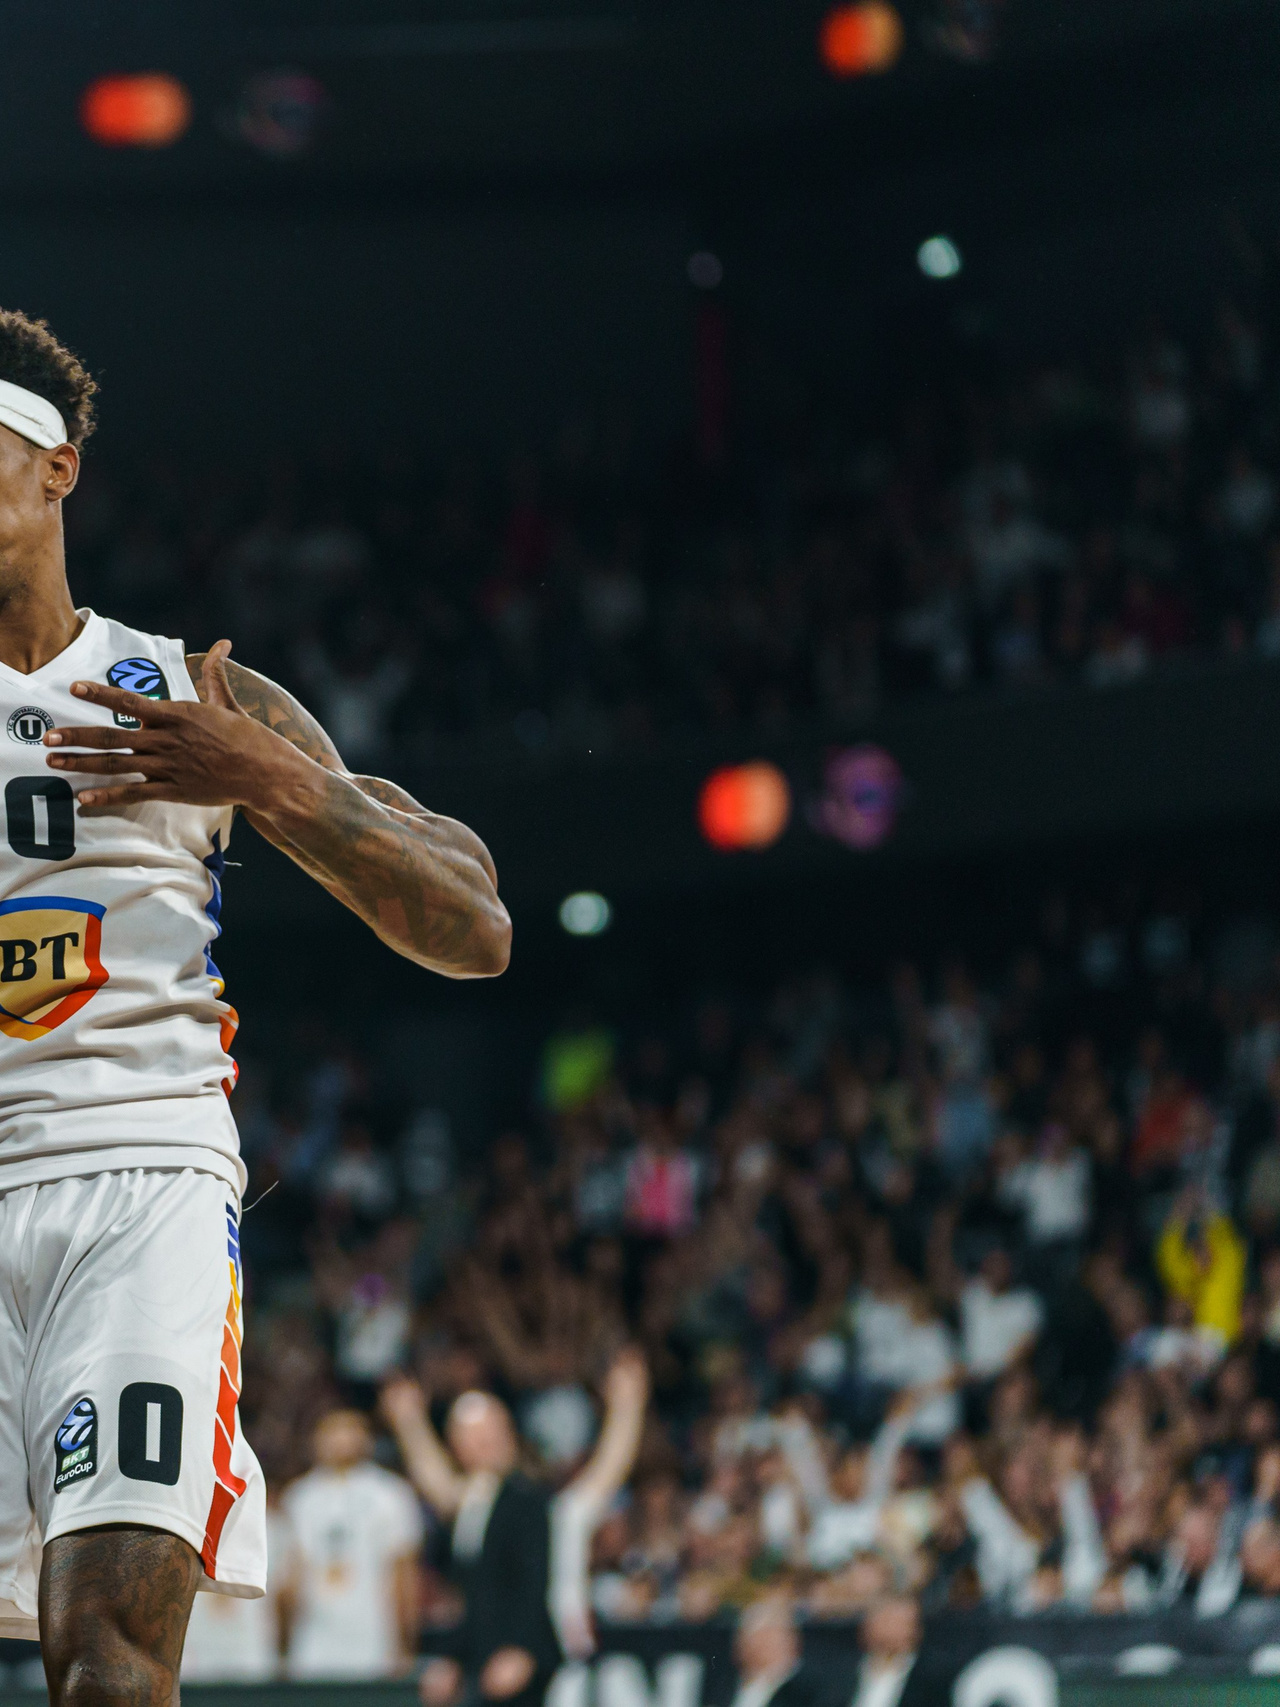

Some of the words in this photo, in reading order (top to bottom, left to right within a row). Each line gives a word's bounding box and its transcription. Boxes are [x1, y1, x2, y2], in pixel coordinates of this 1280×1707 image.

[19, 719, 42, 740] U
[5, 775, 77, 862] 0
[118, 1381, 184, 1487] 0
[62, 1447, 90, 1469] BKT
[56, 1461, 94, 1485] EuroCup
